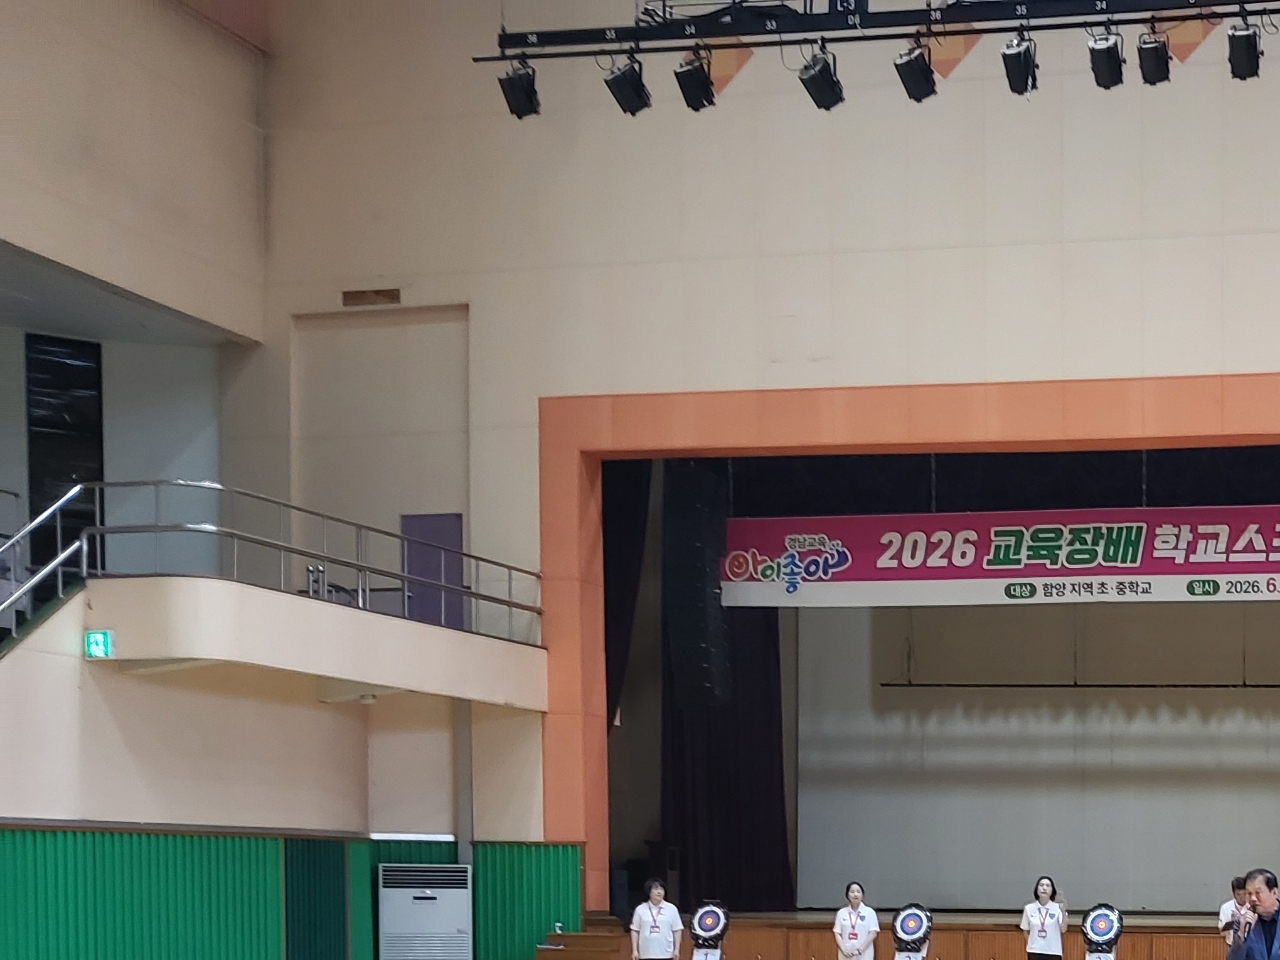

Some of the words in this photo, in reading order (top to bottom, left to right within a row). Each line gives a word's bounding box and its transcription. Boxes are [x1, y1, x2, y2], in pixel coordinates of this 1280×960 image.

[787, 536, 828, 550] 경남교육
[876, 530, 979, 569] 2026
[983, 523, 1146, 568] 교육장배
[726, 548, 852, 594] 아이좋아
[1010, 584, 1032, 597] 대상
[1042, 582, 1067, 598] 함양
[1070, 581, 1094, 596] 지역
[1192, 581, 1214, 594] 일시
[1225, 580, 1263, 594] 2026.
